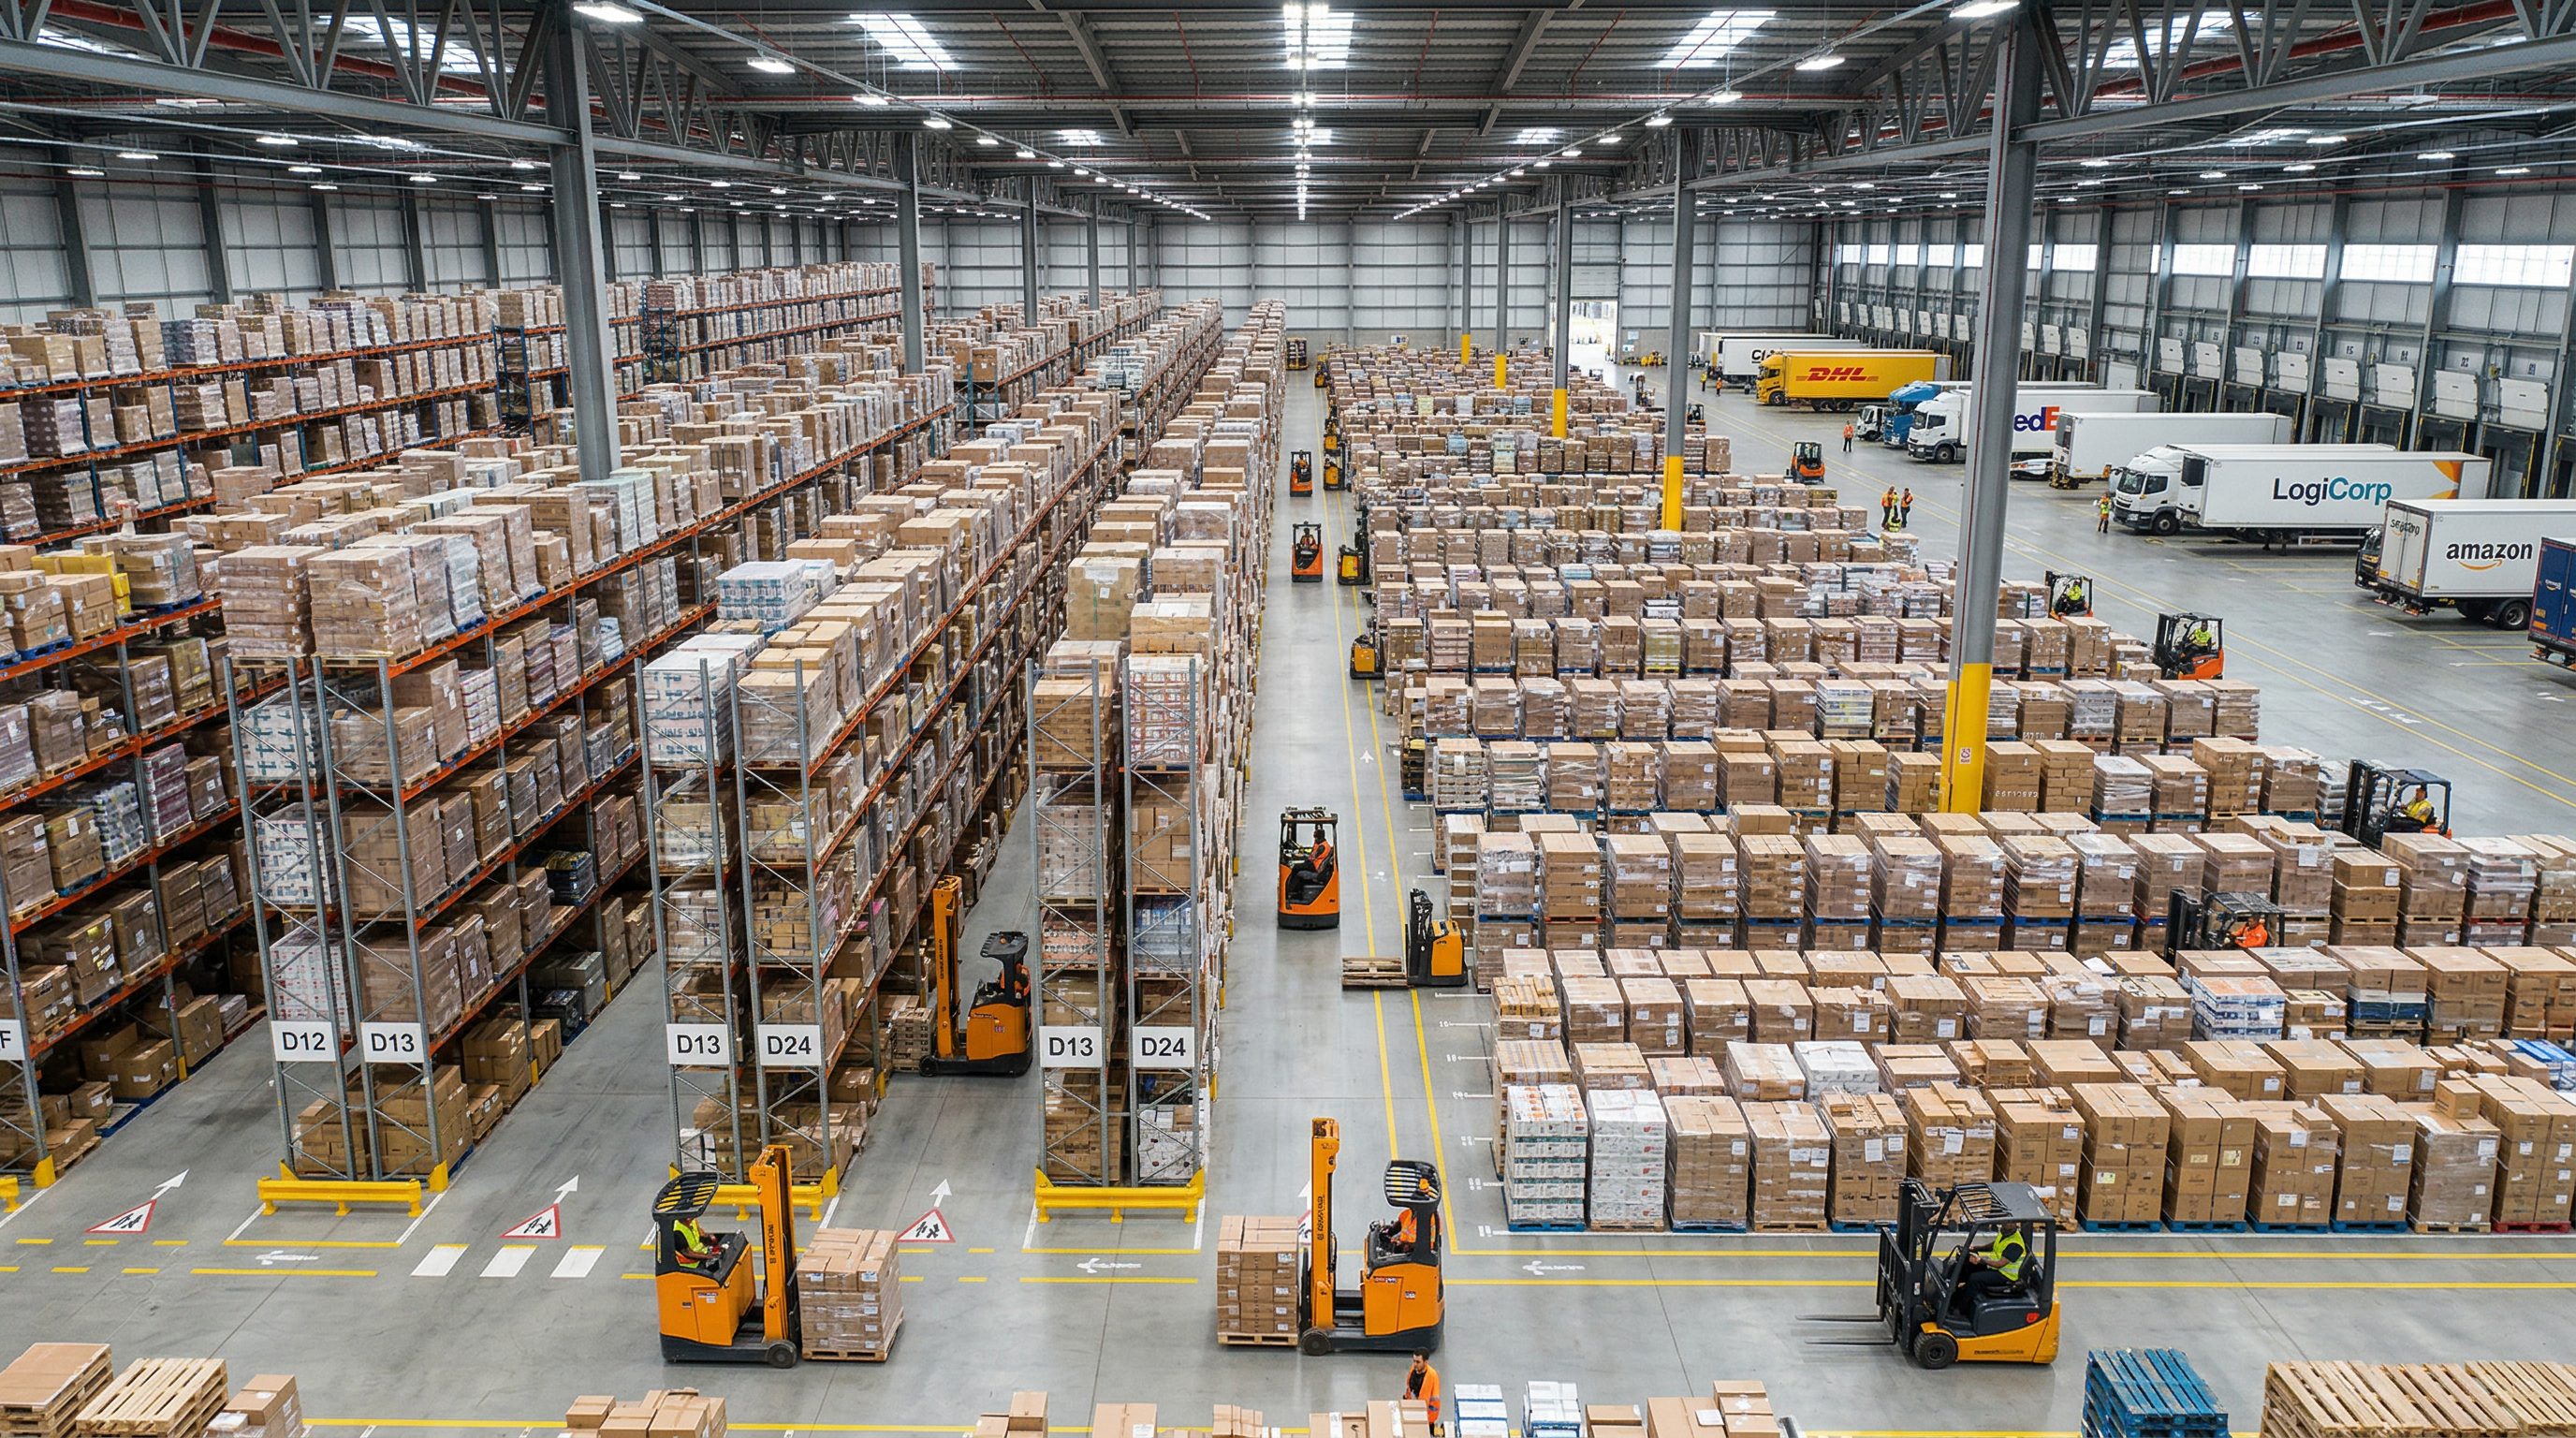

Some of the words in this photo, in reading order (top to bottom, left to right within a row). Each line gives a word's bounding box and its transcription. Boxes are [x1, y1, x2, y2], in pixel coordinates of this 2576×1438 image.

[1808, 367, 1867, 382] DHL
[2013, 406, 2060, 432] edE
[2273, 477, 2393, 506] LogiCorp
[2446, 543, 2533, 560] amazon
[282, 1032, 326, 1050] D12
[371, 1033, 415, 1052] D13
[677, 1034, 721, 1054] D13
[767, 1035, 812, 1055] D24
[1048, 1036, 1093, 1057] D13
[1141, 1036, 1186, 1057] D24
